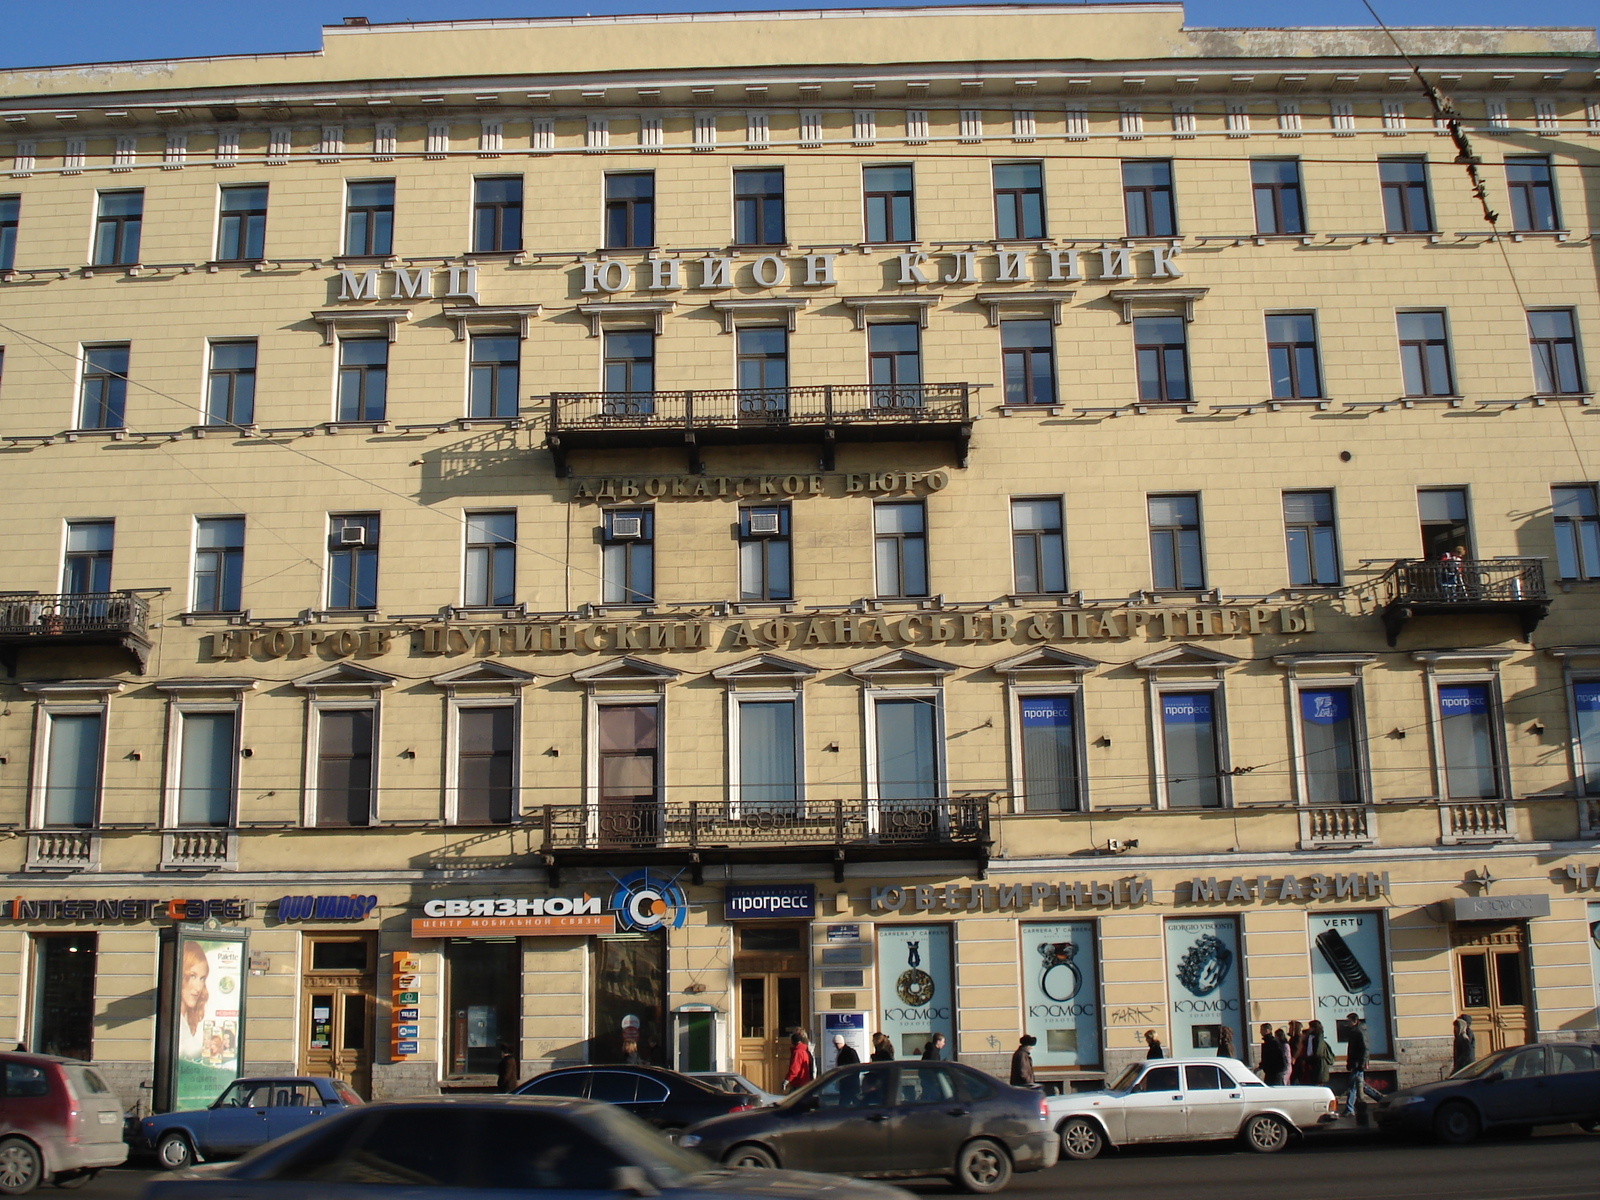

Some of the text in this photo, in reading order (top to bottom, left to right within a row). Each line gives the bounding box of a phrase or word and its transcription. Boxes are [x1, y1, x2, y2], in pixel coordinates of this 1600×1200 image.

[338, 245, 1183, 305] ММЦ ЮНИОН КЛИНИК
[575, 470, 949, 501] АДВОКАТСКОЕ БЮРО
[210, 629, 392, 659] ЕГОРОВ
[421, 619, 712, 654] ПУГИНСКИЙ
[732, 611, 1016, 647] АФАНАСЬЕВ
[1061, 605, 1316, 639] ПАРТНЕРЫ
[1441, 697, 1485, 708] прогресс
[1024, 709, 1068, 719] прогресс
[1165, 705, 1210, 716] прогресс
[870, 871, 1391, 911] ЮВЕЛИРНЫЙ МАГАЗИН
[278, 895, 316, 922] QUO
[423, 891, 602, 918] СВЯЗНОЙ
[732, 895, 808, 913] прогресс
[1473, 898, 1532, 913] КОСМОС
[422, 917, 601, 928] ЦЕНТР МОБИЛЬНОЙ СВЯЗИ
[1168, 924, 1199, 933] GIORGIO
[1323, 918, 1363, 927] VERTU
[1174, 999, 1239, 1013] КОСМОС
[1317, 994, 1382, 1008] КОСМОС
[884, 1007, 949, 1021] КОСМОС
[1029, 1003, 1094, 1018] КОСМОС
